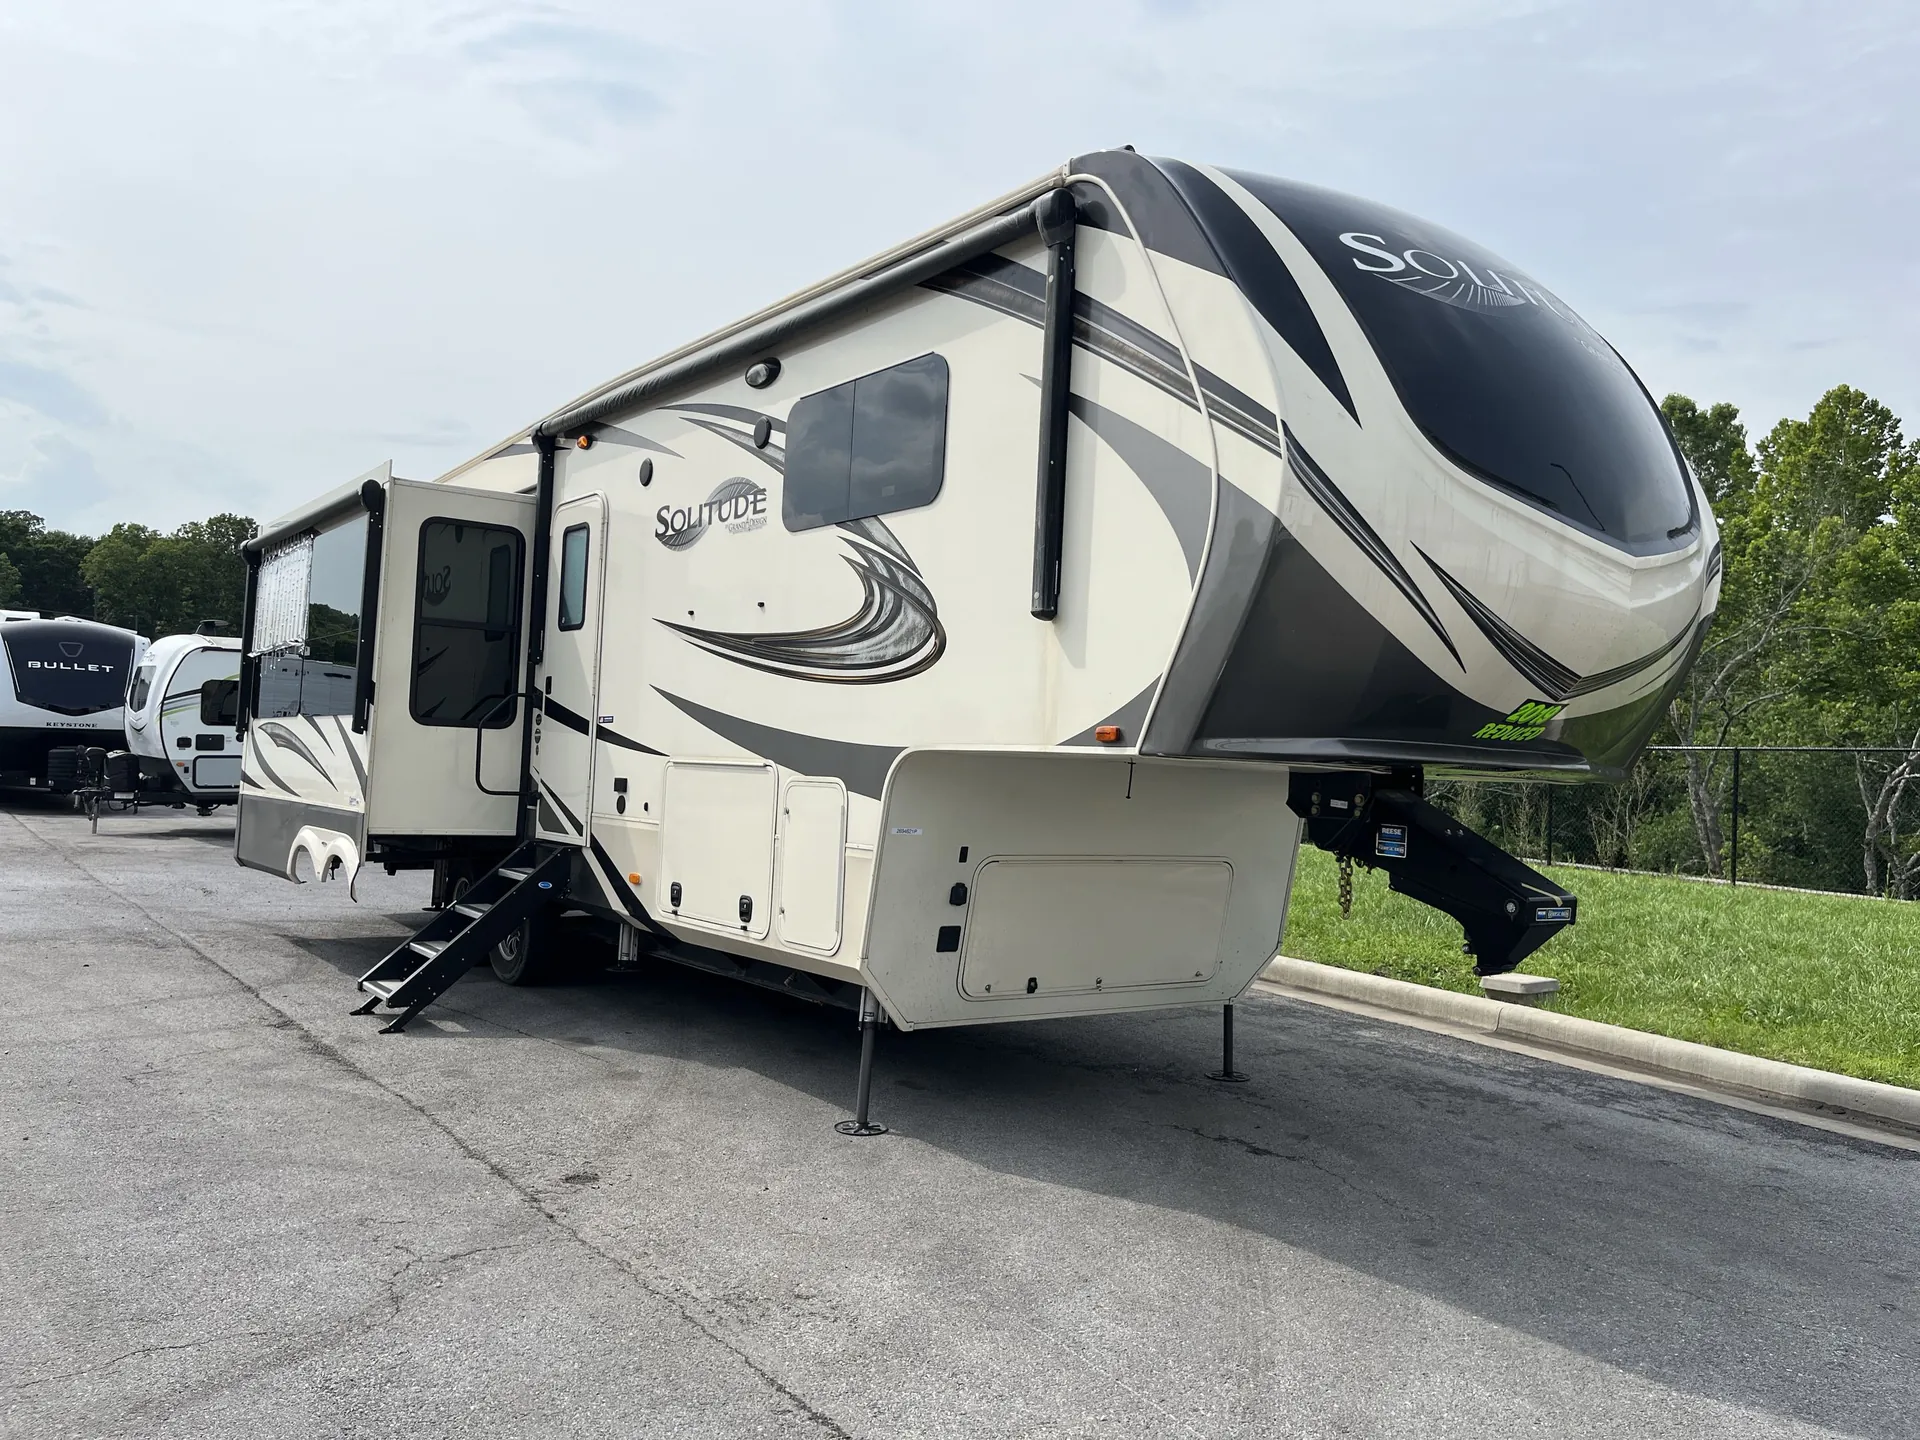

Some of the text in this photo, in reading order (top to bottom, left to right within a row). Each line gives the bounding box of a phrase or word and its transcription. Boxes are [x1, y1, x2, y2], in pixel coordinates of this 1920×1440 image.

[655, 488, 767, 538] SOLITUDE
[728, 521, 747, 533] GRAND
[749, 516, 768, 527] DESIGN
[27, 660, 114, 673] BULLET
[1505, 702, 1562, 726] 2019
[1471, 722, 1547, 742] REDUCED
[1381, 827, 1402, 836] REESE
